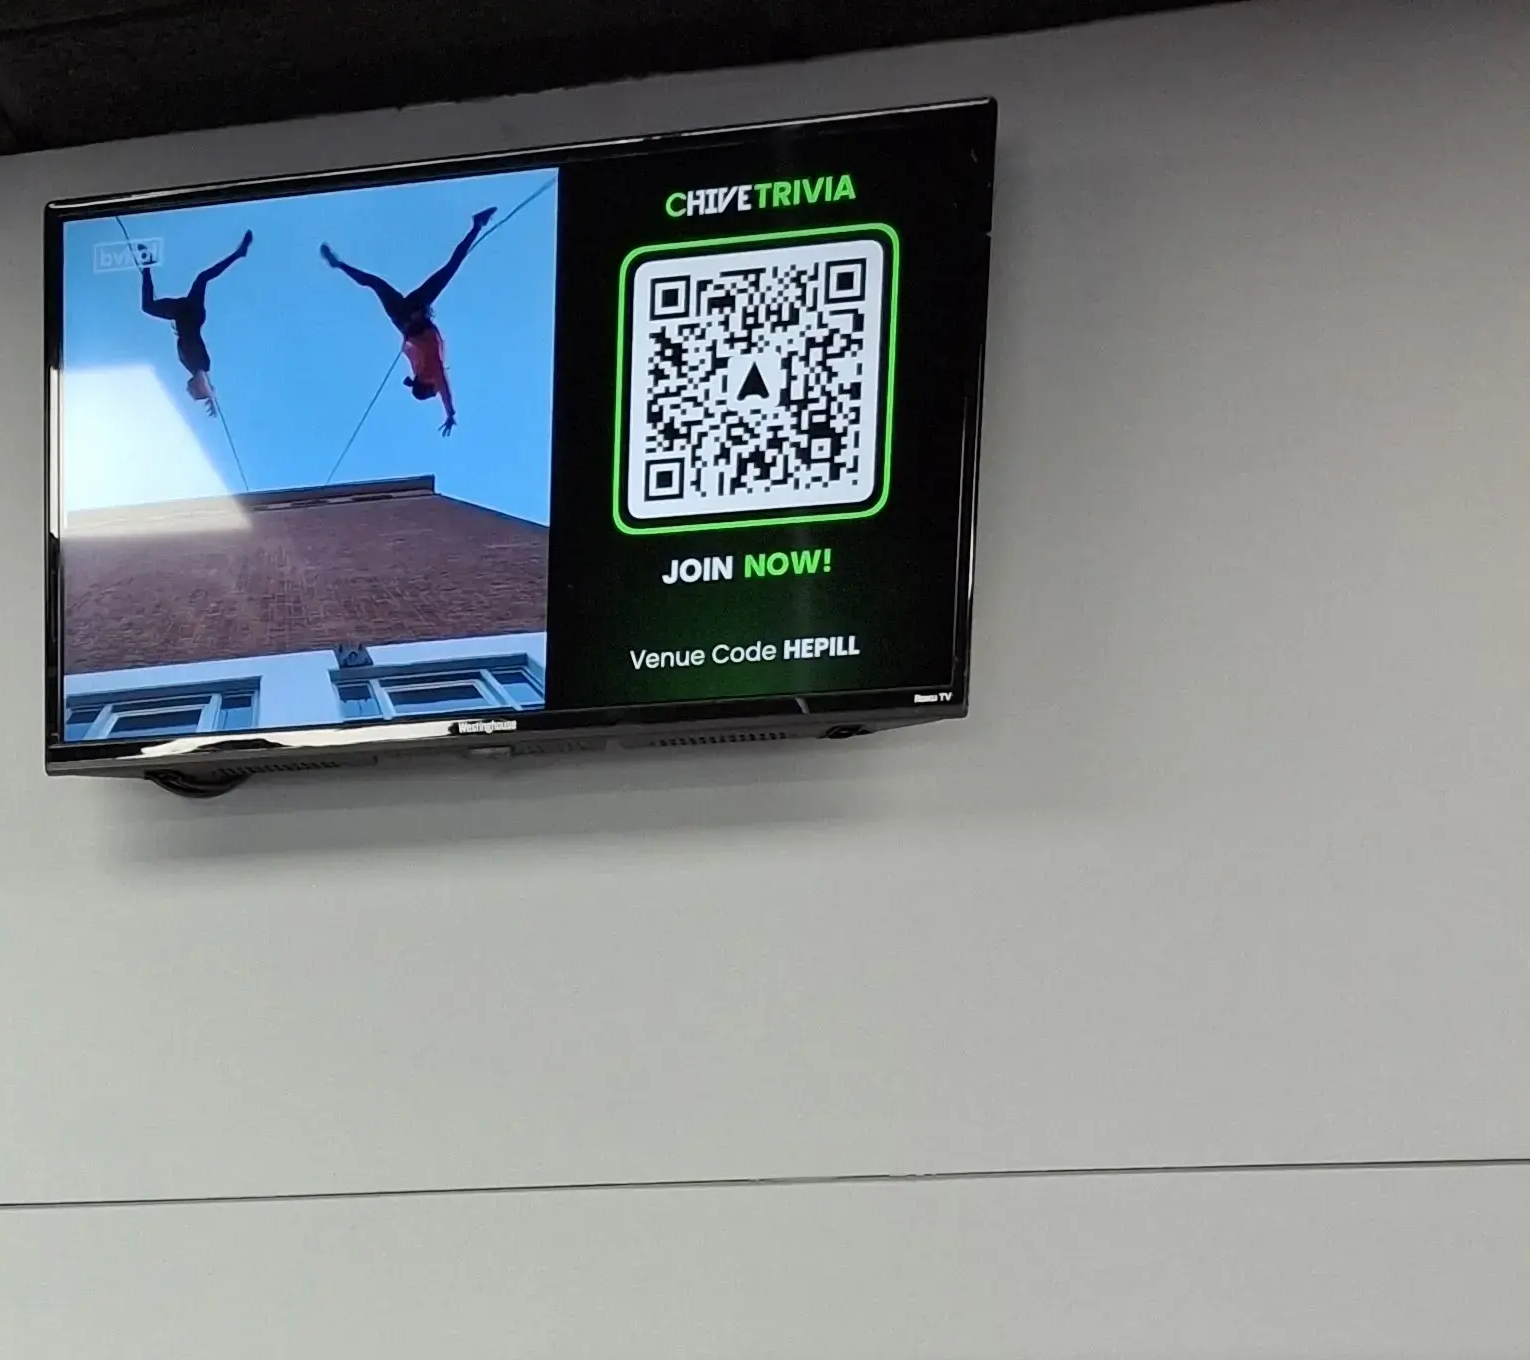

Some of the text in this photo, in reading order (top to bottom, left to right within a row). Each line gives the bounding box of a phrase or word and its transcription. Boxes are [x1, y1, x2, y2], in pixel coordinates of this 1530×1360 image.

[662, 548, 832, 584] JOIN NOW!
[630, 636, 860, 670] Venue Code HEPILL
[938, 692, 953, 702] TV
